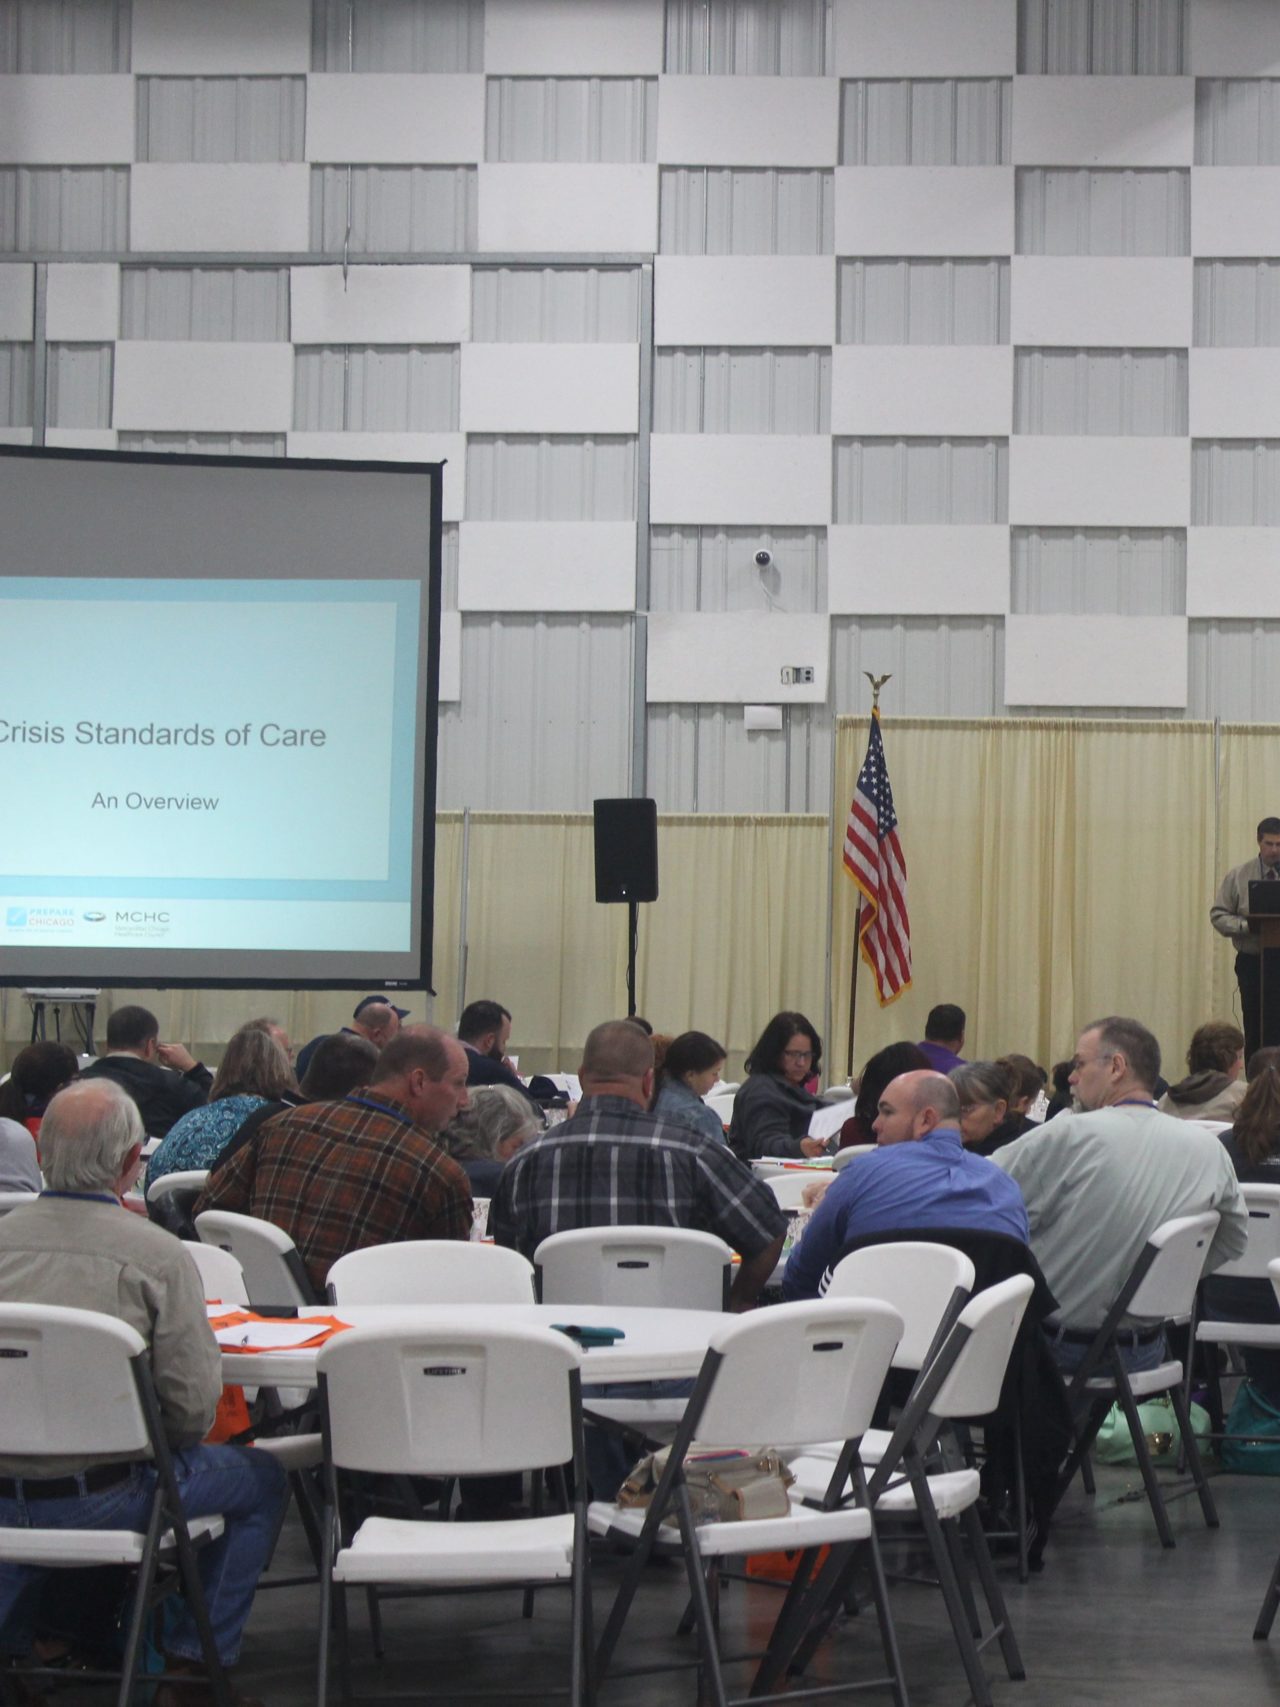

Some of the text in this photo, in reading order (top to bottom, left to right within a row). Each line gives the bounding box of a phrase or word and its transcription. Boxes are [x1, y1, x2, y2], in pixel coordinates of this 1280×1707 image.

[75, 720, 216, 746] Standards
[224, 722, 252, 746] of
[260, 723, 327, 747] Care
[91, 791, 220, 811] An Overview
[29, 917, 75, 927] CHICAGO
[115, 911, 170, 923] MCHC
